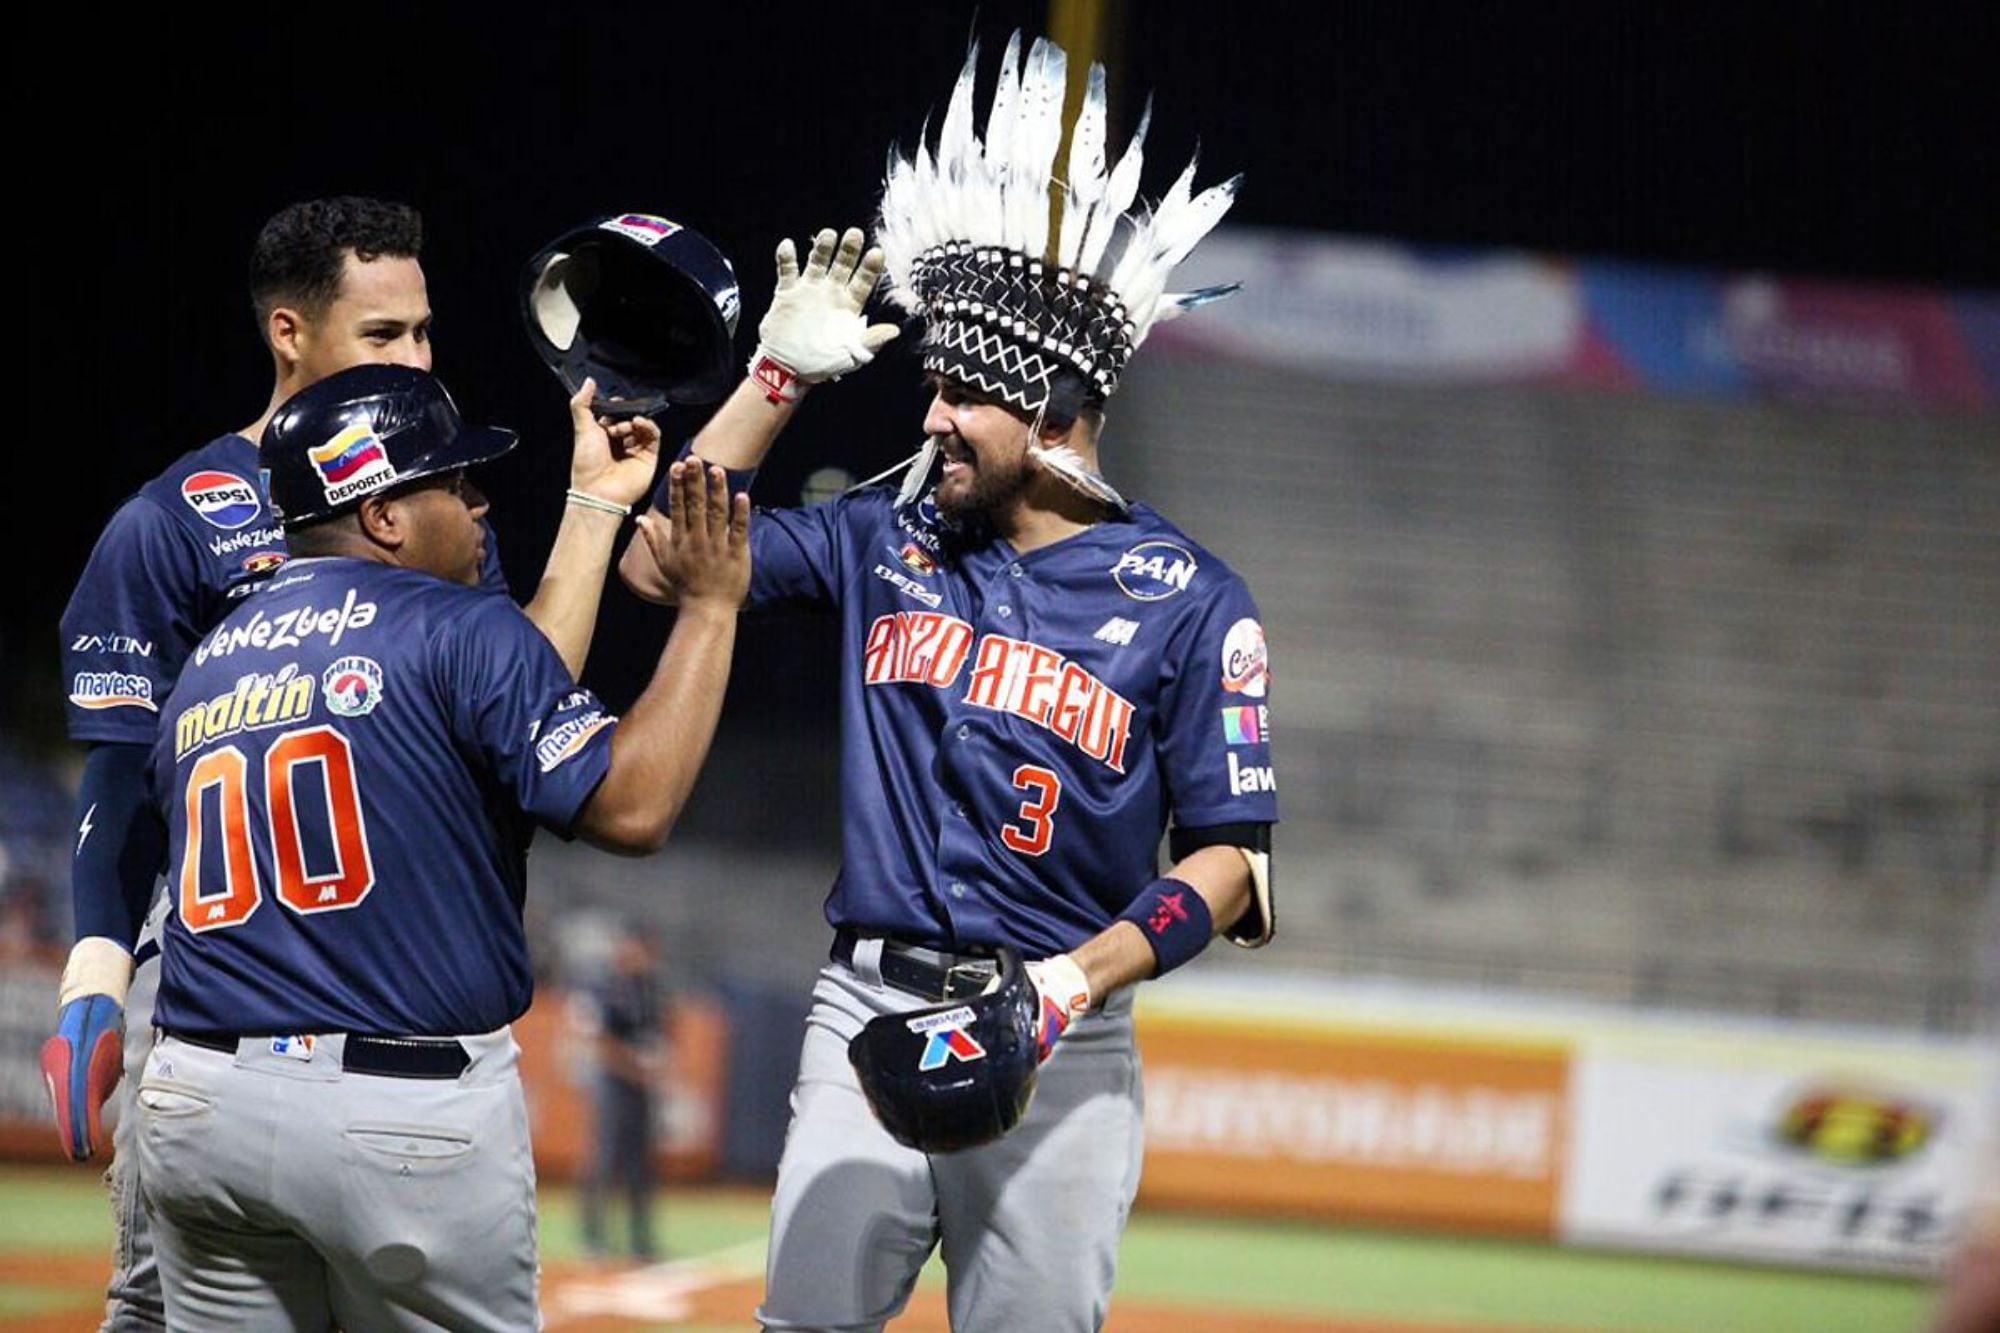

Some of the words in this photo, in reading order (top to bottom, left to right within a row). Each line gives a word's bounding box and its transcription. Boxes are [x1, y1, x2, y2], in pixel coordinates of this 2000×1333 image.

[189, 488, 253, 506] PEPSI
[328, 467, 395, 501] DEPORTE
[874, 564, 944, 608] BERA
[74, 671, 152, 700] mavesa
[179, 724, 375, 934] 00
[1001, 764, 1061, 856] 3
